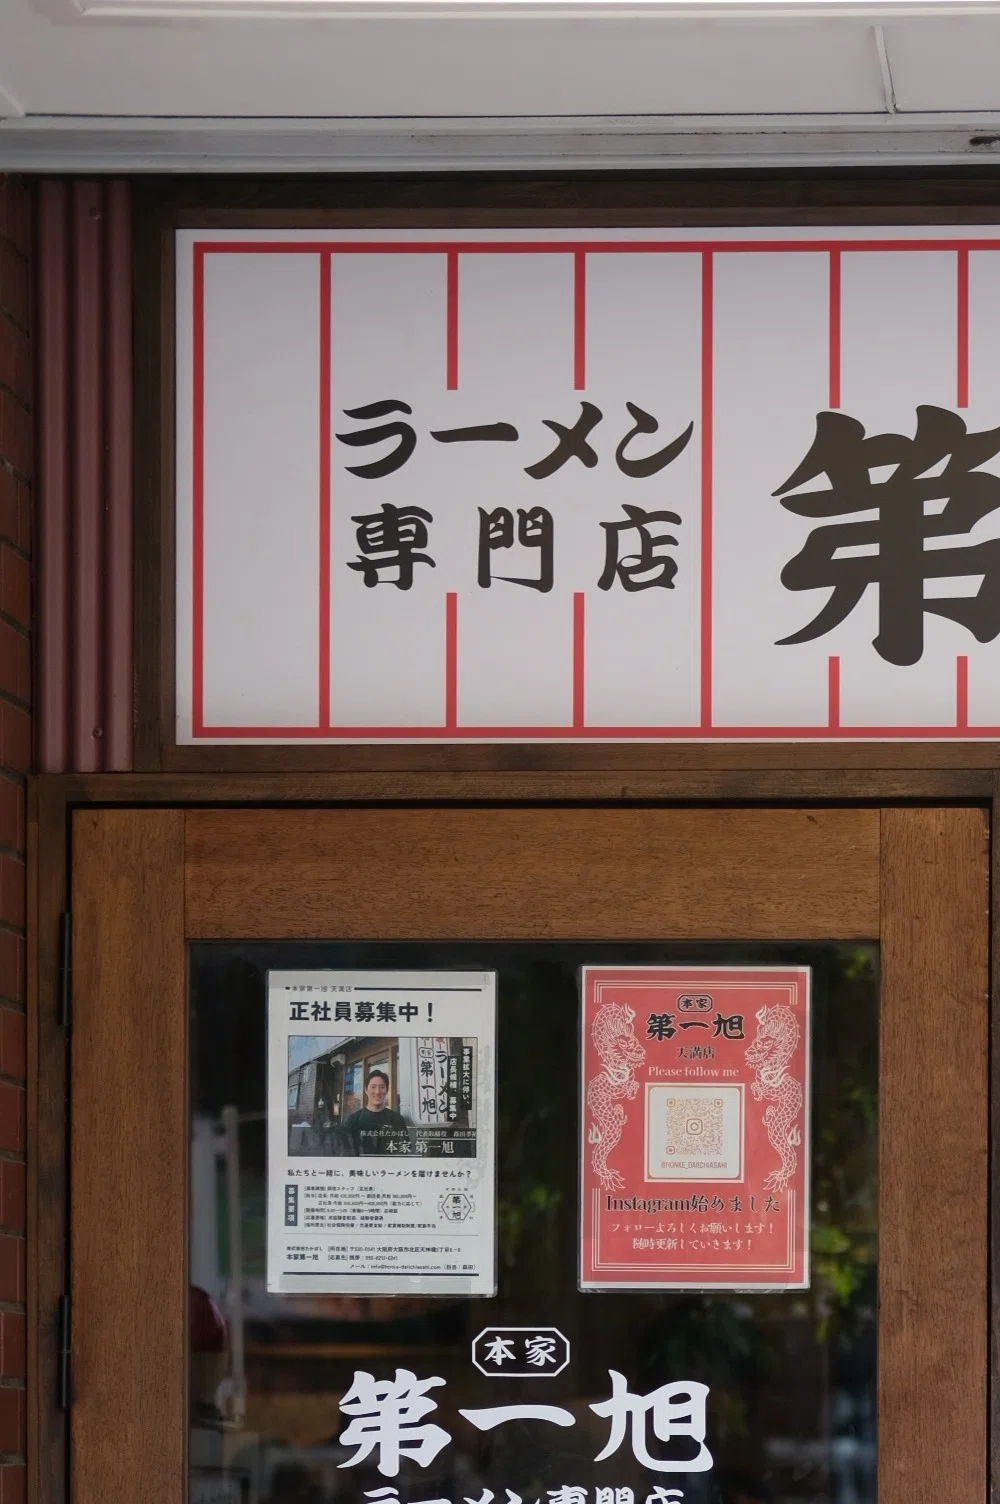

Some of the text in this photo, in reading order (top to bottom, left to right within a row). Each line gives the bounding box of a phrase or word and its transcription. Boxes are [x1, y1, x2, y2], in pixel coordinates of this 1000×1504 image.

[335, 399, 694, 479] ラーメン
[345, 503, 682, 593] 専門店
[289, 1001, 434, 1023] 正社員募集中！
[682, 998, 708, 1009] 本家
[646, 1013, 745, 1041] 第一旭
[678, 1046, 715, 1059] 天満店
[648, 1066, 739, 1077] Please follow me
[385, 1140, 455, 1154] 本家 第一旭
[606, 1194, 781, 1214] Instagram始めました
[484, 1336, 558, 1367] 本家
[336, 1368, 714, 1478] 第一旭
